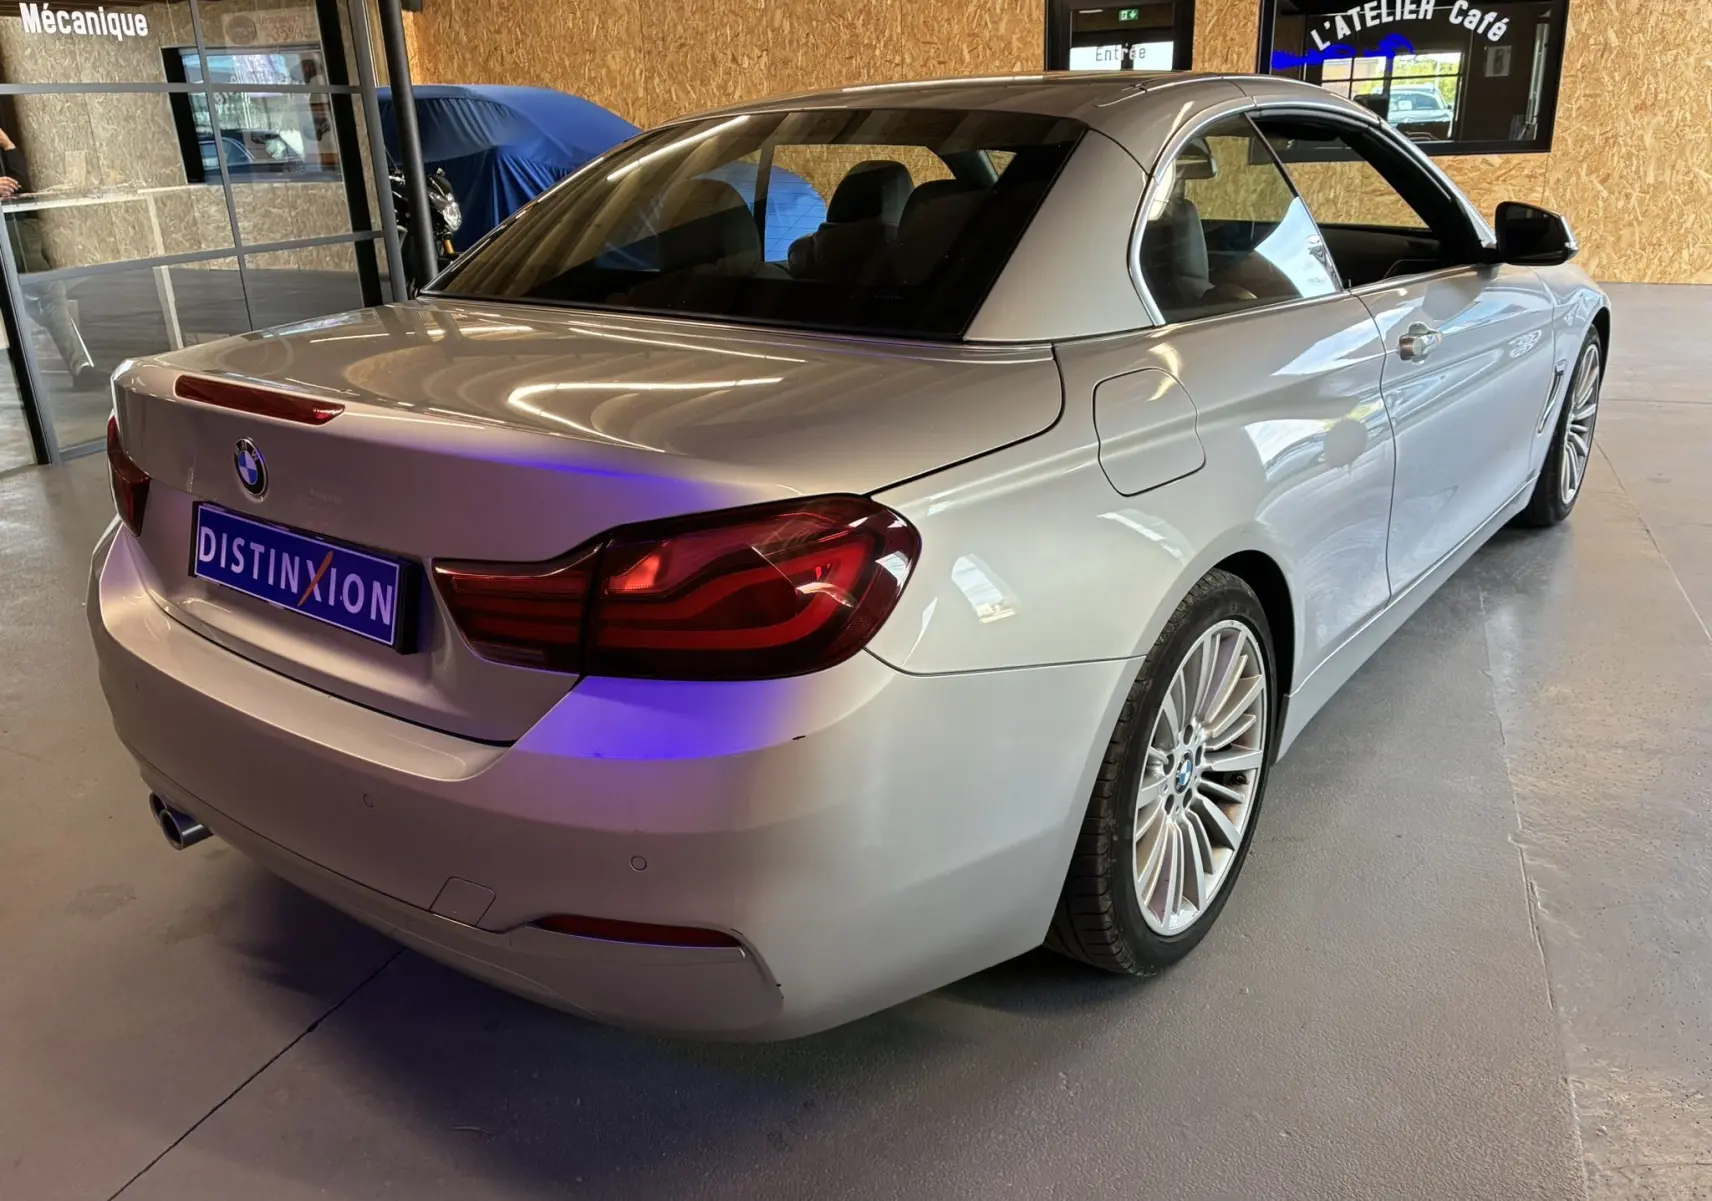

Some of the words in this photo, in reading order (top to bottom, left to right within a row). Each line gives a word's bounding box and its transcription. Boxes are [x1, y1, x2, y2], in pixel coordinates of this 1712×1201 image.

[19, 3, 149, 41] Mécanique
[1310, 0, 1435, 51] L'ATELIER
[1449, 0, 1510, 42] Café
[1095, 43, 1146, 62] Entrée
[199, 526, 393, 625] DISTINXION
